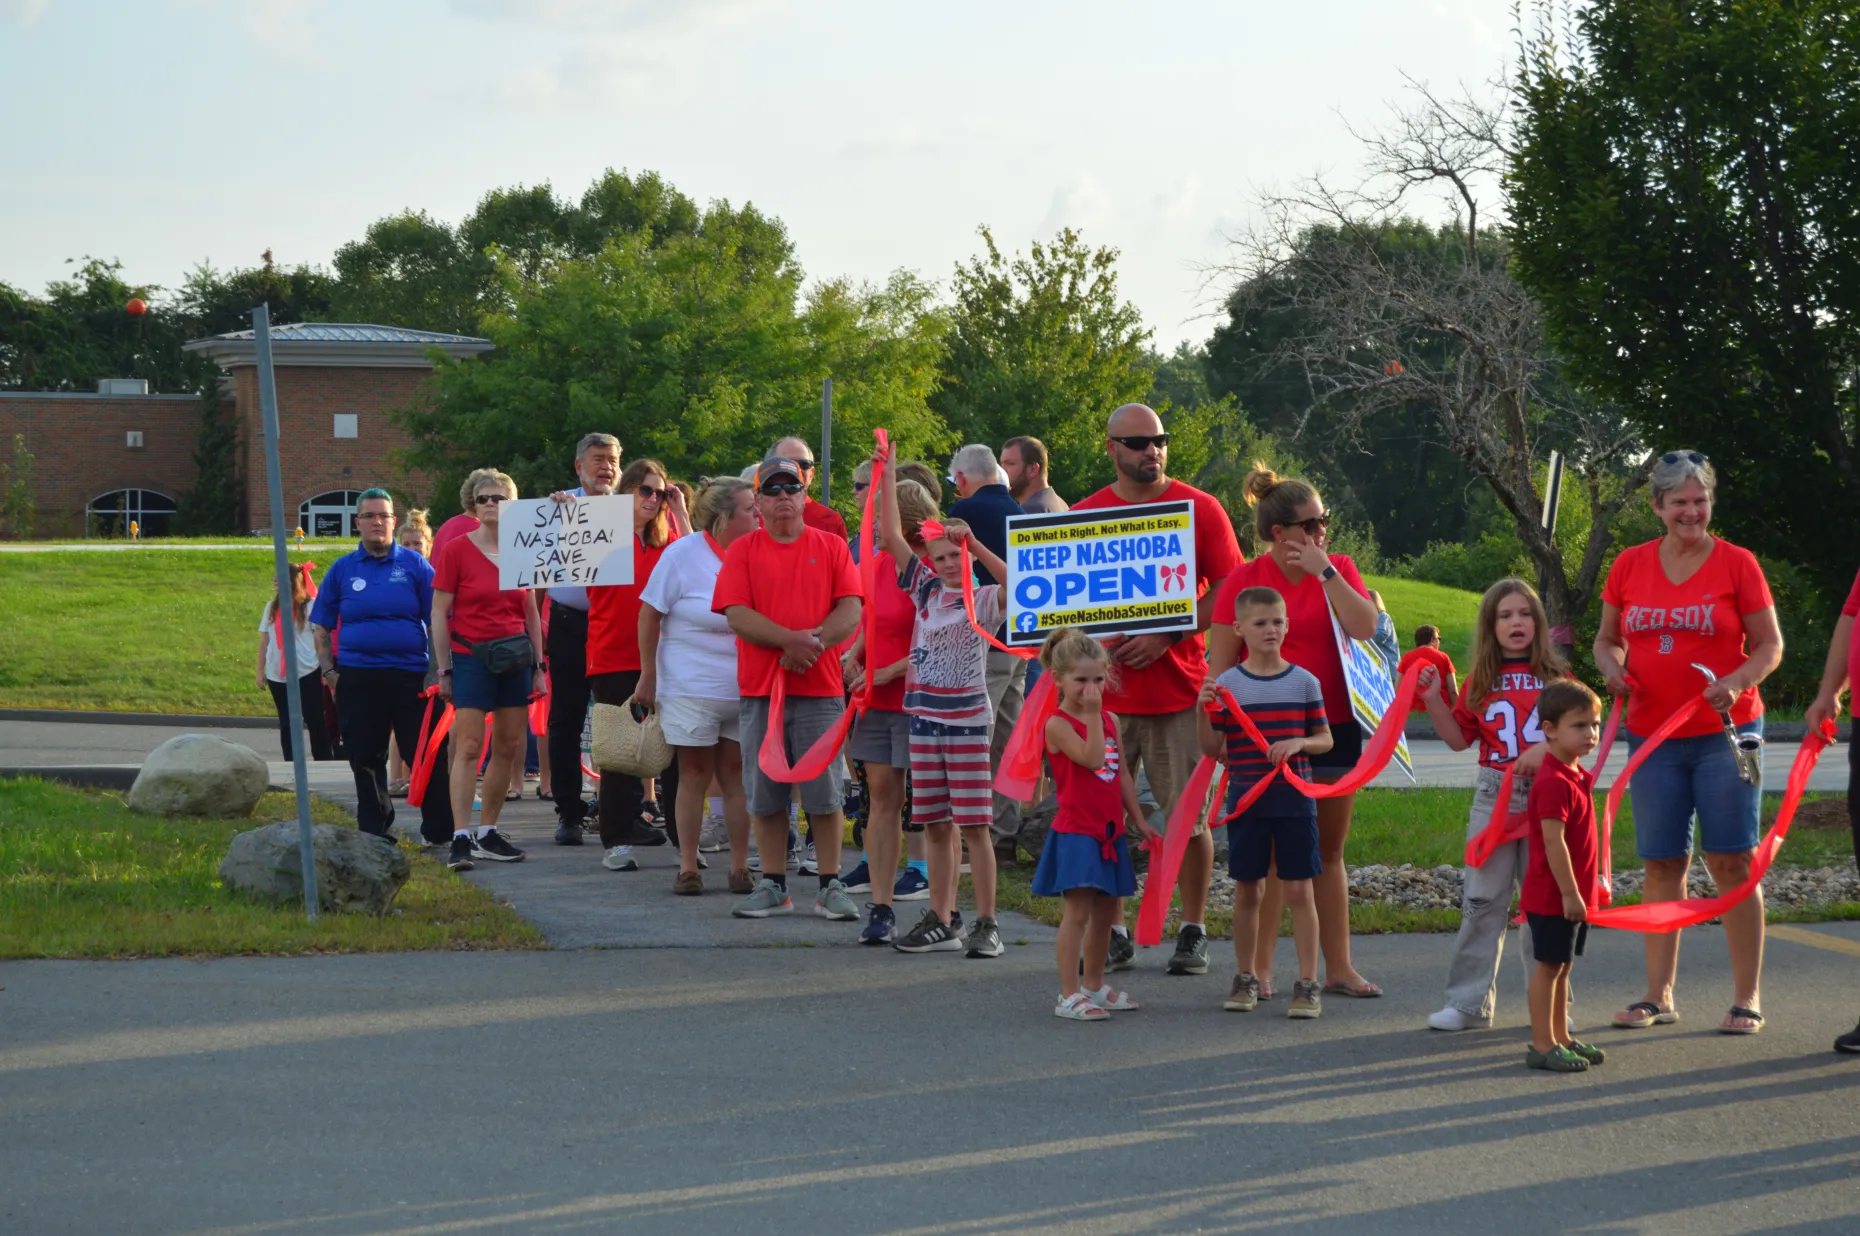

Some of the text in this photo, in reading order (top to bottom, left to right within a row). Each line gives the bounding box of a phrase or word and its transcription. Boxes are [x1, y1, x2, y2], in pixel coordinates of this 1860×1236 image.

[534, 503, 589, 528] SAVE
[514, 529, 614, 548] NASHOBA!
[1018, 518, 1181, 542] Do What Is Right. Not What Is Easy.
[534, 549, 586, 568] SAVE
[1018, 534, 1182, 572] KEEP NASHOBA
[518, 567, 598, 588] LIVES!!
[1015, 564, 1157, 609] OPEN
[1041, 602, 1187, 627] #SaveNashobaSaveLives
[1625, 604, 1716, 636] RED SOX
[1658, 634, 1674, 654] B
[1485, 700, 1546, 762] 34
